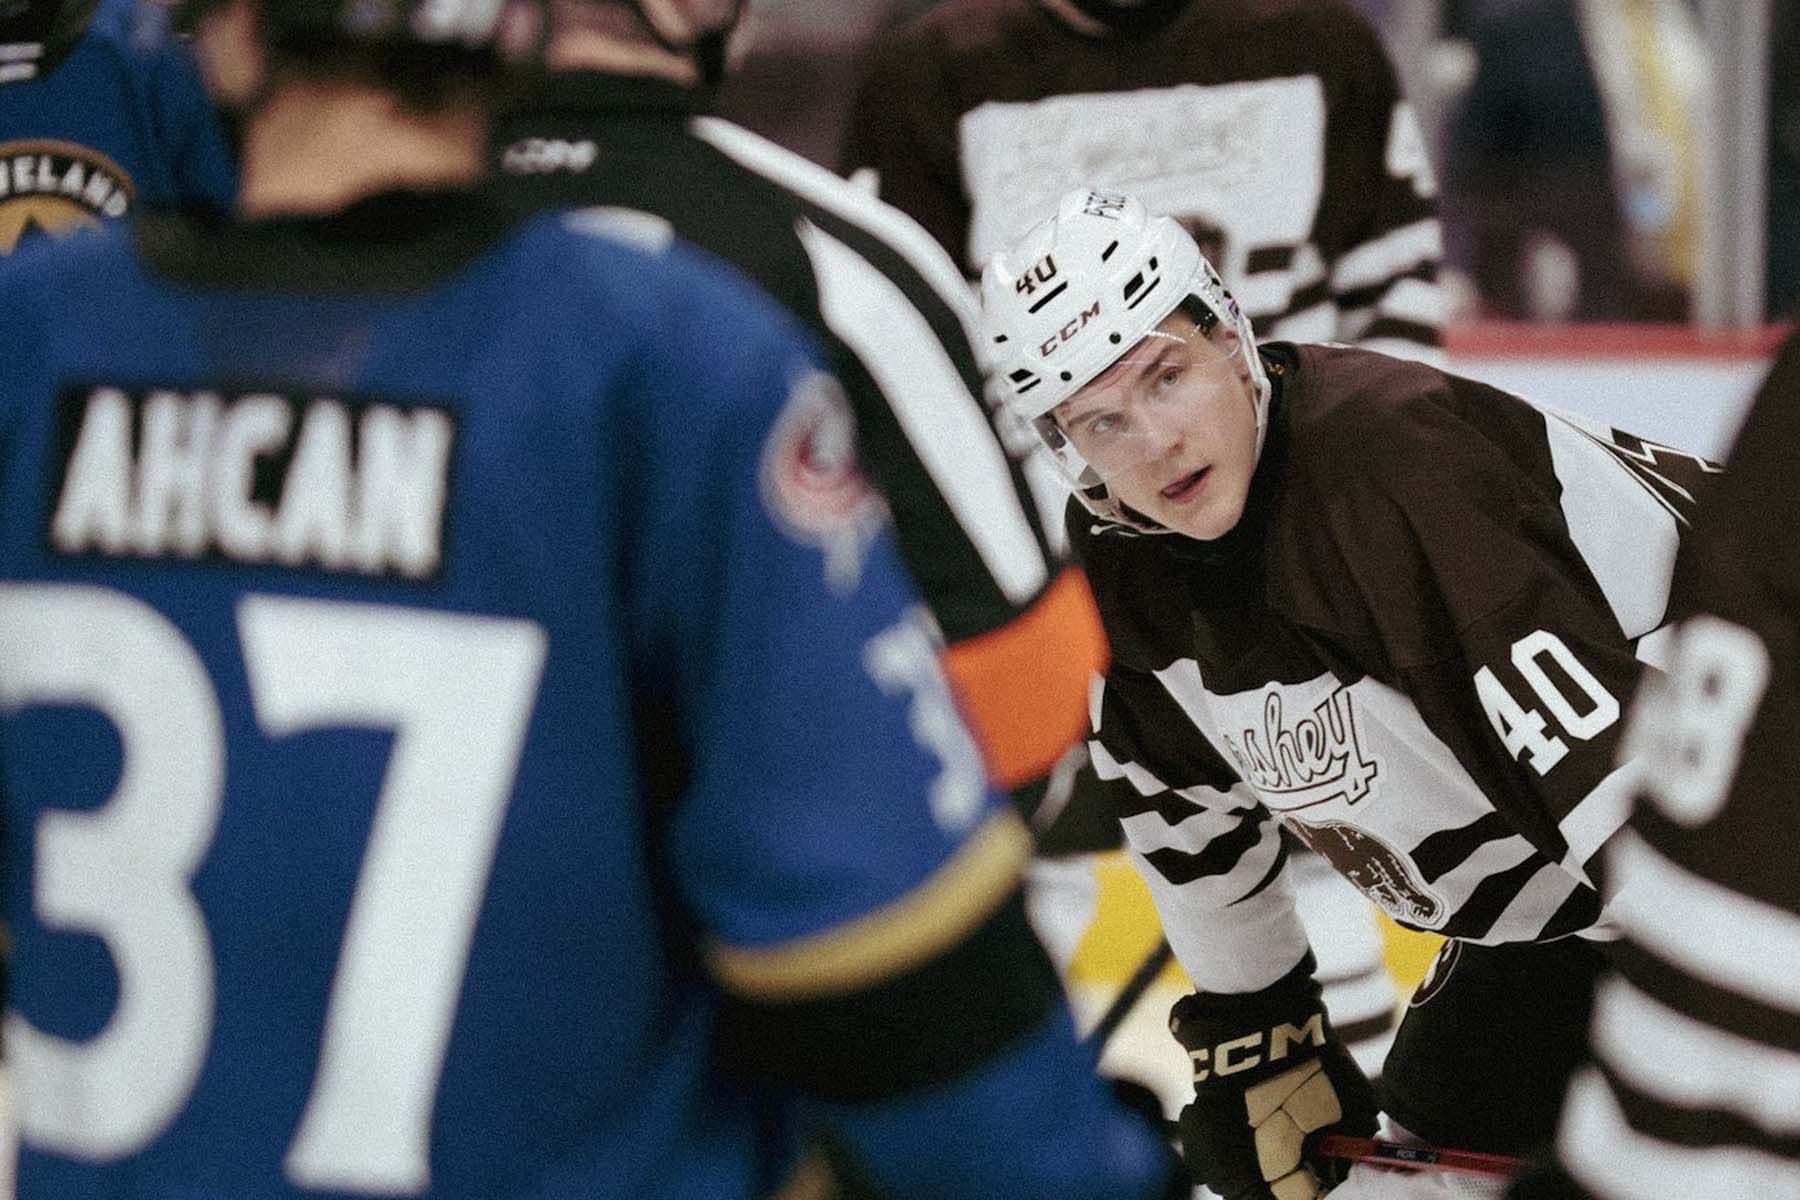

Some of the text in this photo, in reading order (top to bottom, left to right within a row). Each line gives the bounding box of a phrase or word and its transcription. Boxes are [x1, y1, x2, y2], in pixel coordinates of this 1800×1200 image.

[1015, 253, 1057, 295] 40
[1040, 300, 1100, 357] CCM
[52, 388, 453, 579] AHCAN
[1473, 629, 1621, 777] 40
[0, 583, 548, 1196] 37
